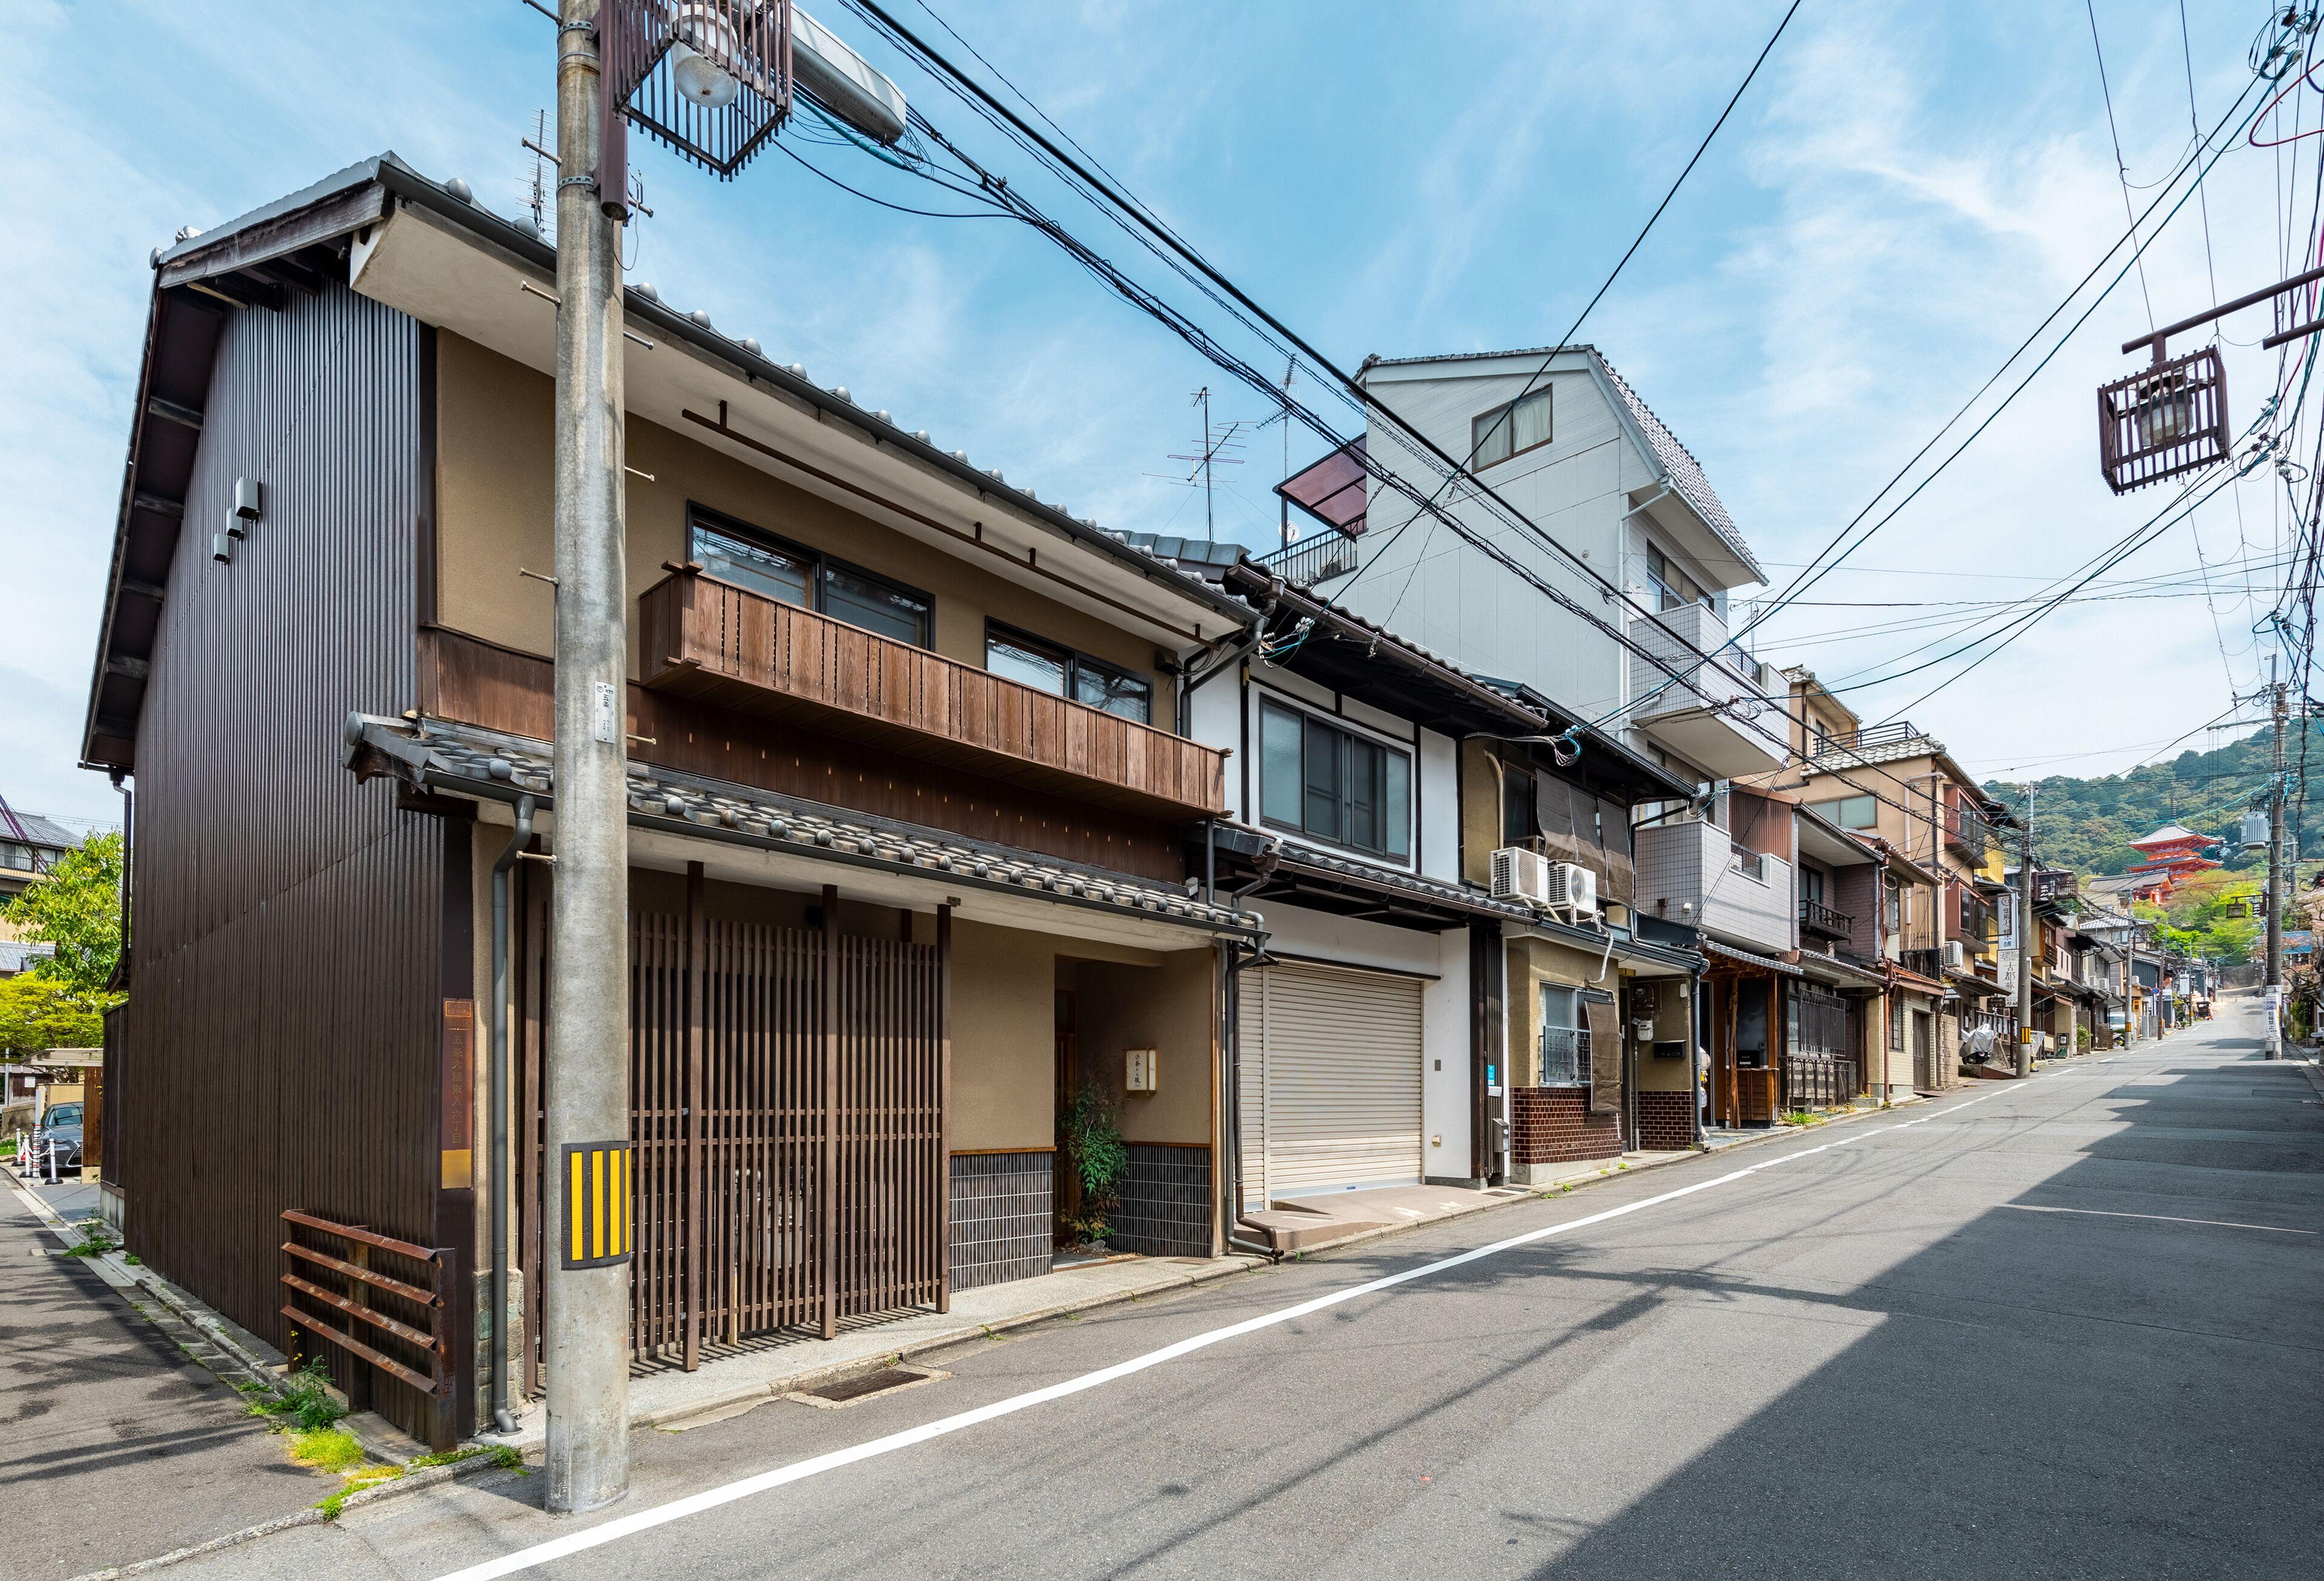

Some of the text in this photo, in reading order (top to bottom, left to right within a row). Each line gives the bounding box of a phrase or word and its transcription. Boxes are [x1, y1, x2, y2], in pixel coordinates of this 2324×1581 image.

[451, 1035, 463, 1144] 五条大橋東入六丁目
